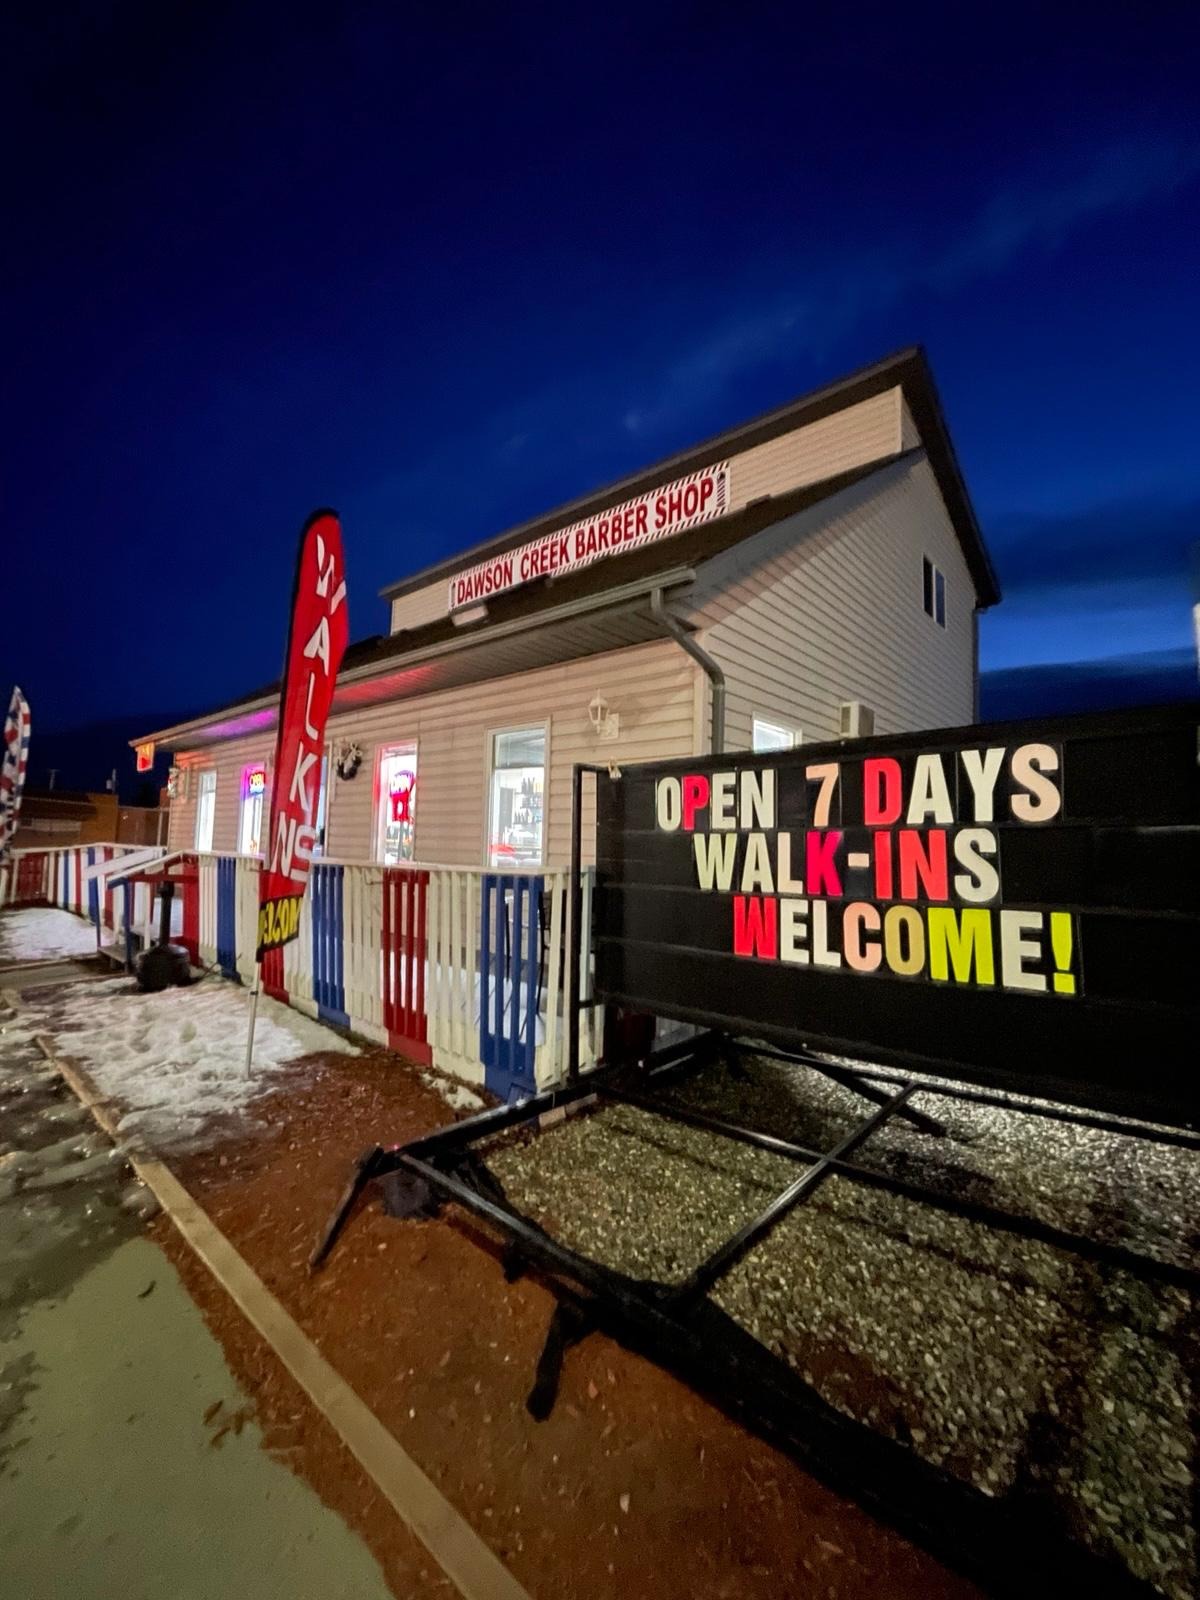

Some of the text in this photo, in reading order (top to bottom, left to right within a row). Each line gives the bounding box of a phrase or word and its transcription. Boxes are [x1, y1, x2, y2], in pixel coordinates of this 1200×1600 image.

[457, 477, 714, 603] DAWSON CREEK BARBER SHOP
[657, 743, 1060, 832] OPEN 7 DAYS
[694, 828, 999, 903] WALK-INS
[733, 896, 1075, 994] WELCOME!
